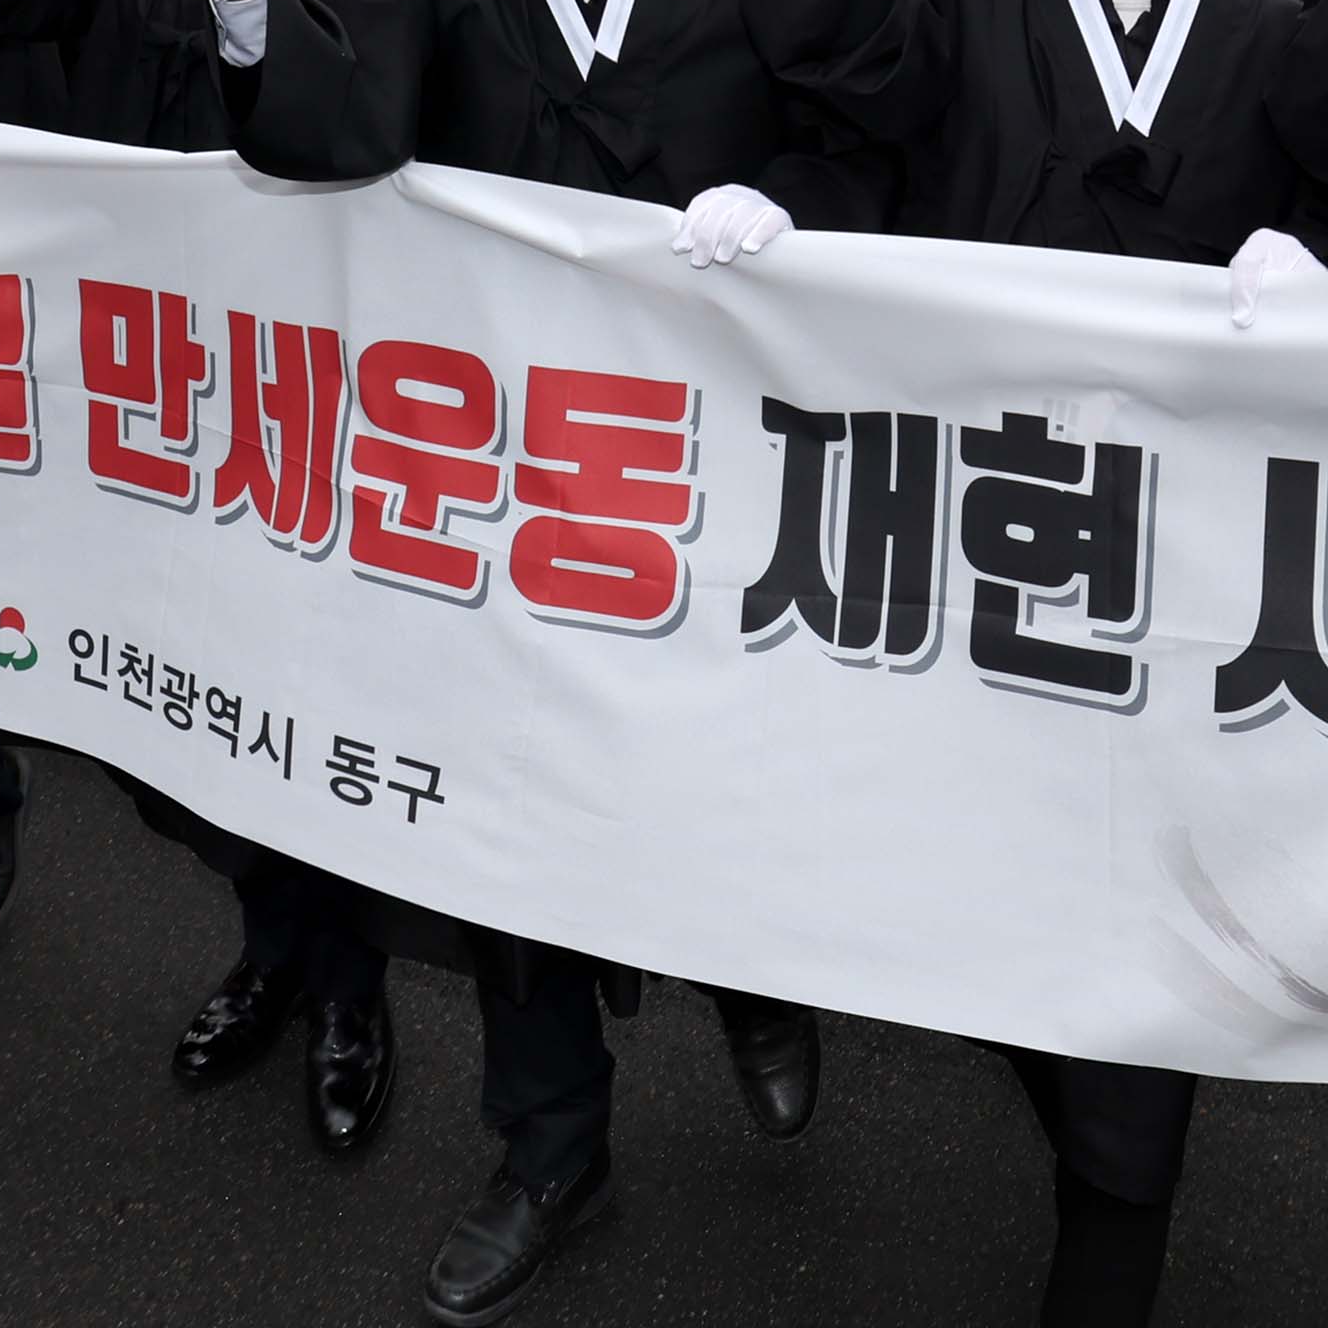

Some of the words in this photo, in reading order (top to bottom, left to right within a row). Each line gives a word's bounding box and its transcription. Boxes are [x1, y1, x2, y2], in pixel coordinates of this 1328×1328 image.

[77, 277, 703, 639] 만세운동
[740, 394, 1160, 716] 재현
[68, 626, 294, 780] 인천광역시
[325, 733, 446, 824] 동구
